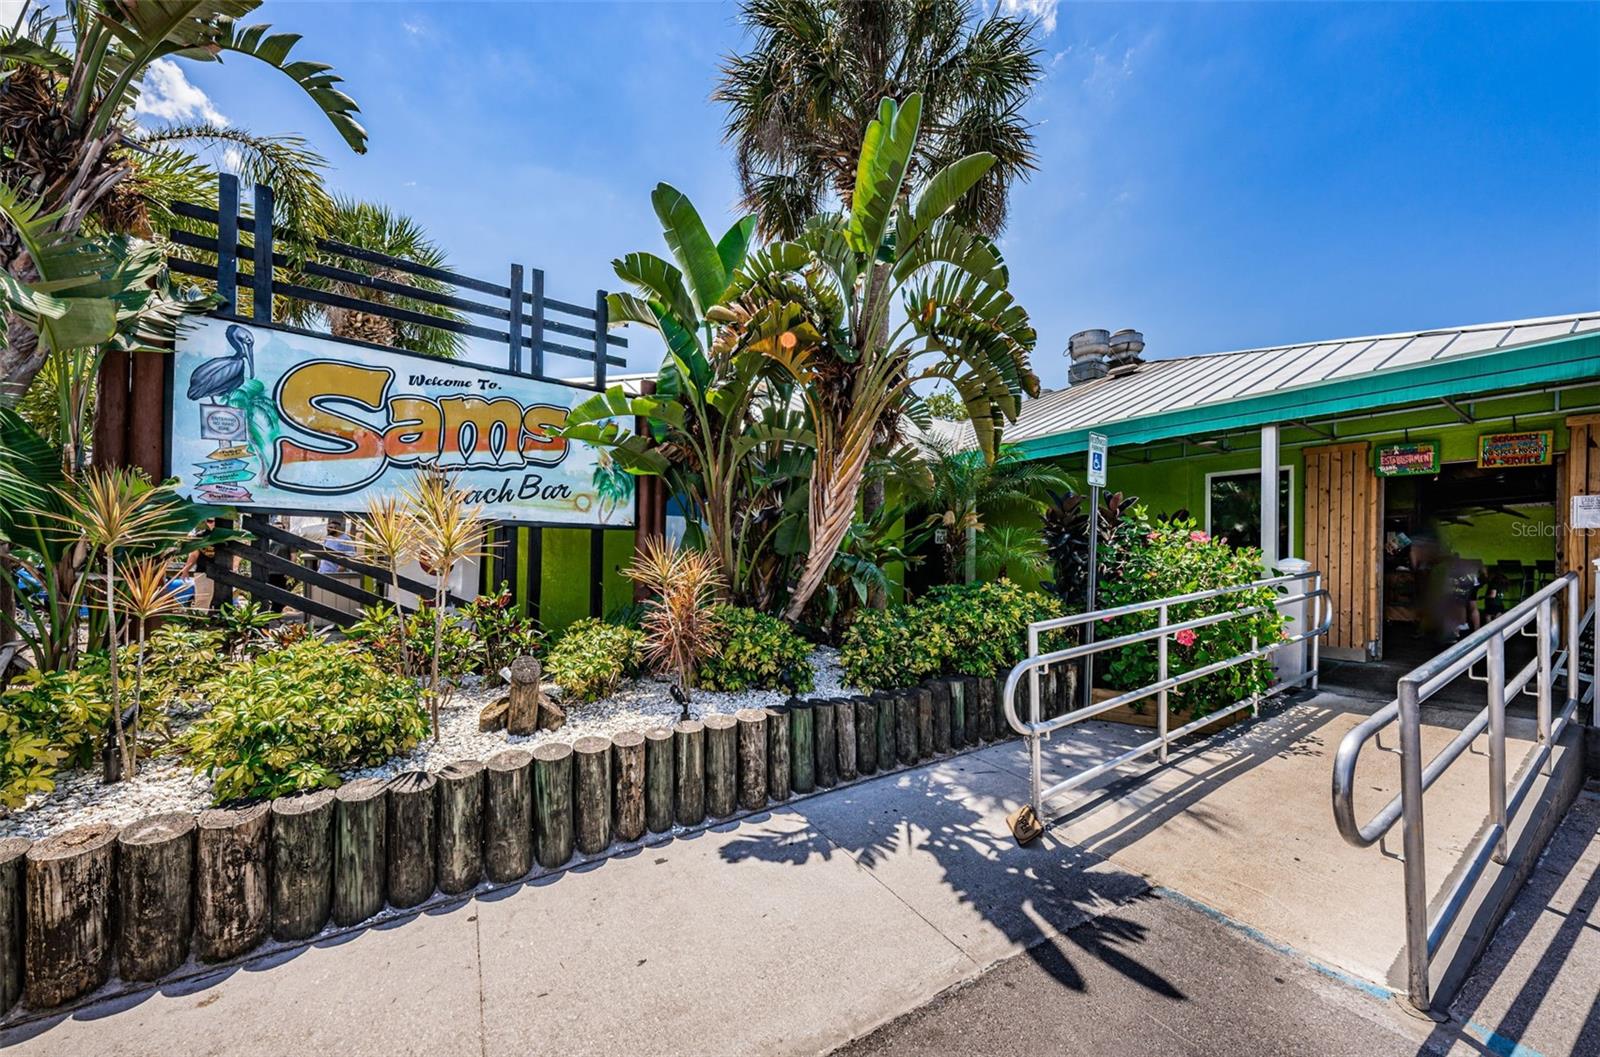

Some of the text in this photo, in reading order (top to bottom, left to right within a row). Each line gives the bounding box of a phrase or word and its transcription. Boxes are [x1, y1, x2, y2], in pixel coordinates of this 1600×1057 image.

[409, 374, 472, 388] Welcome
[267, 357, 572, 495] Sams
[518, 473, 571, 500] Bar
